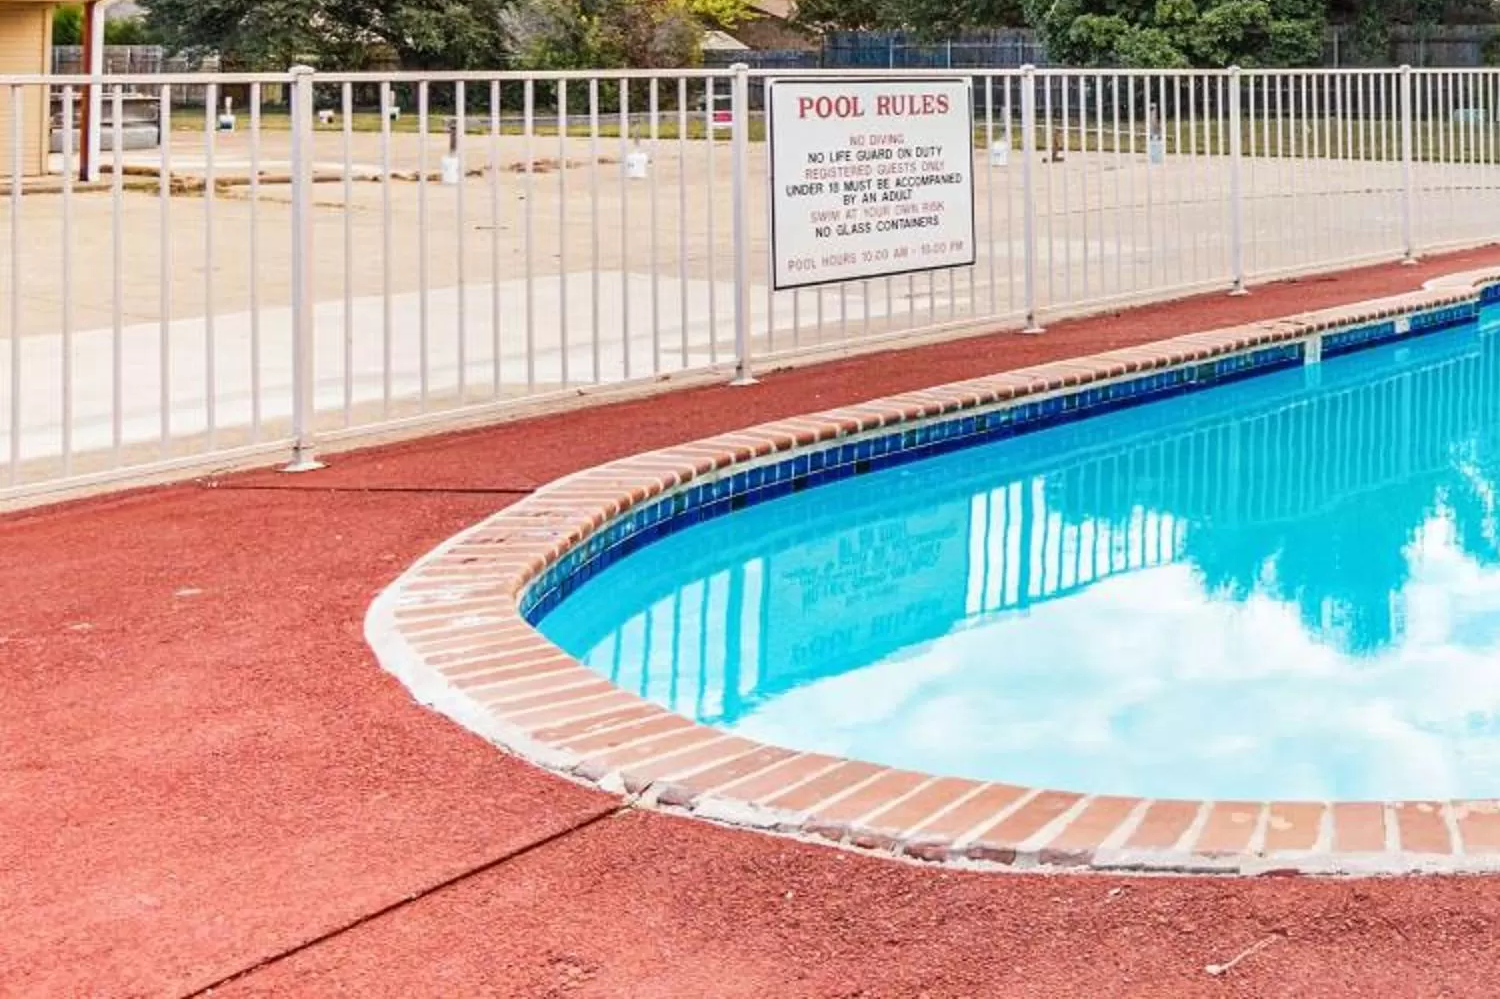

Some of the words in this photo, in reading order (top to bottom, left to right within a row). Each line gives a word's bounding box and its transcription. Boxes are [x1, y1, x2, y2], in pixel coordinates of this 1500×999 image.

[798, 96, 865, 118] POOL
[876, 94, 949, 115] RULES
[850, 136, 864, 145] NO
[870, 134, 904, 145] DIVING
[808, 152, 825, 163] NO
[829, 151, 851, 162] LIFE
[856, 148, 892, 160] GUARD
[897, 148, 911, 159] ON
[916, 146, 942, 157] DUTY
[805, 165, 871, 179] REGISTERED
[877, 162, 916, 175] GUESTS
[922, 161, 944, 171] ONLY
[786, 183, 823, 197] UNDER
[844, 179, 872, 192] MUST
[877, 178, 890, 189] BE
[895, 173, 962, 188] ACCOMPANIED
[843, 194, 856, 205] BY
[862, 192, 876, 202] AN
[882, 190, 912, 201] ADULT
[810, 210, 840, 222] SWIM
[845, 208, 857, 219] AT
[864, 206, 891, 217] YOUR
[895, 204, 919, 215] OWN
[922, 201, 944, 212] RISK
[815, 227, 830, 238] NO
[836, 223, 871, 236] GLASS
[876, 215, 939, 231] CONTAINERS
[788, 258, 816, 271] POOL
[822, 254, 856, 266] HOURS
[894, 246, 908, 258] AM
[950, 241, 963, 250] PM
